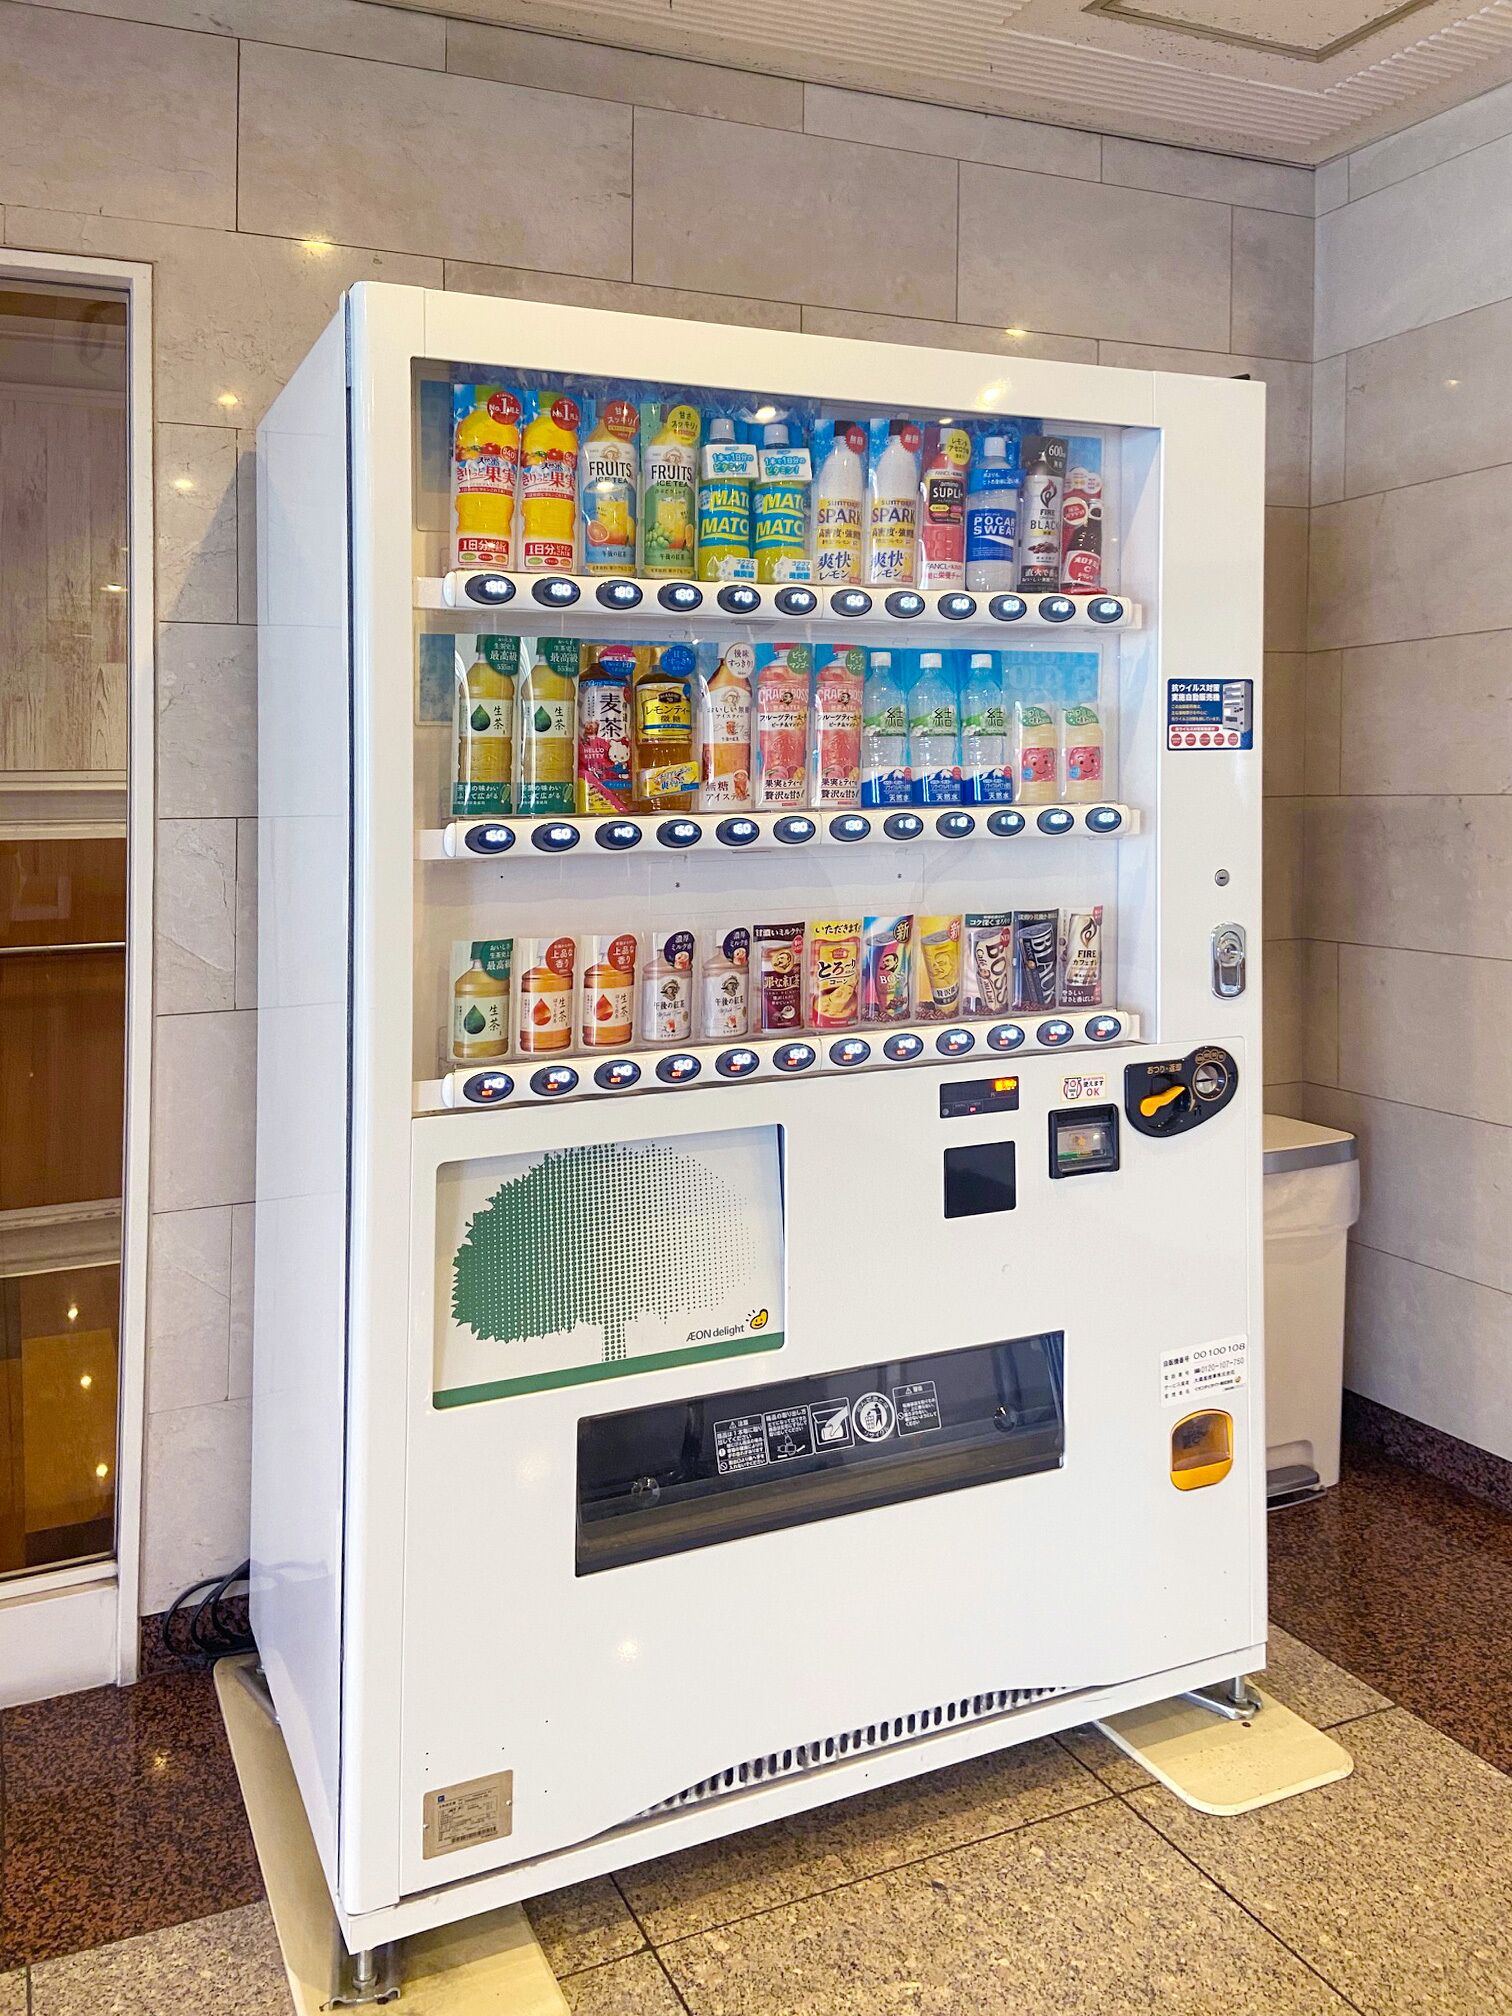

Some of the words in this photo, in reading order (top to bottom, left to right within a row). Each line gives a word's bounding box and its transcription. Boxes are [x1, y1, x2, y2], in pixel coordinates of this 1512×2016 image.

[589, 461, 632, 478] FRUITS
[651, 464, 693, 482] FRUITS
[613, 477, 629, 485] TEA
[657, 480, 671, 488] ICE
[528, 544, 555, 555] 1日分
[817, 551, 851, 570] 爽快
[820, 570, 849, 580] レモン
[727, 659, 752, 668] すっきり
[1171, 684, 1220, 693] 抗ウイルス対策
[600, 688, 623, 738] 麦茶
[645, 704, 691, 715] レモンティー
[493, 705, 504, 730] 生茶
[554, 706, 565, 731] 生茶
[457, 784, 499, 792] 茶の味わい
[551, 948, 573, 958] 上品な
[613, 945, 635, 956] 上品な
[1077, 950, 1097, 958] FIRE
[1030, 928, 1055, 1004] BLACK
[559, 998, 567, 1021] 生茶
[489, 1004, 500, 1031] 生茶
[1086, 1087, 1100, 1096] OK
[713, 1323, 745, 1337] delight
[1193, 1342, 1246, 1361] 00100108
